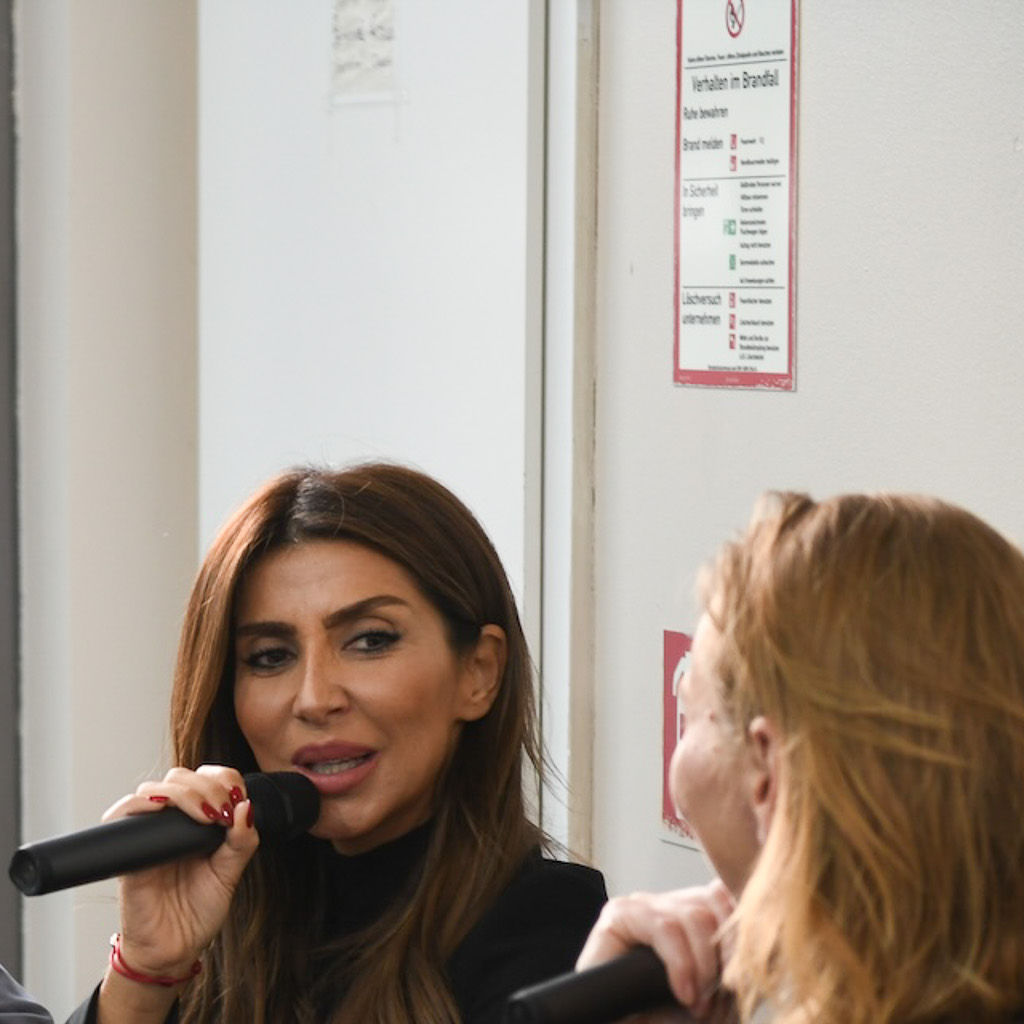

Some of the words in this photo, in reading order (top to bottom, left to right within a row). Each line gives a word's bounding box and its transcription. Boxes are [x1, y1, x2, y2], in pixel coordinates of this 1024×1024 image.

[691, 73, 728, 92] Verhalten
[730, 72, 741, 89] im
[742, 69, 780, 88] Brandfall
